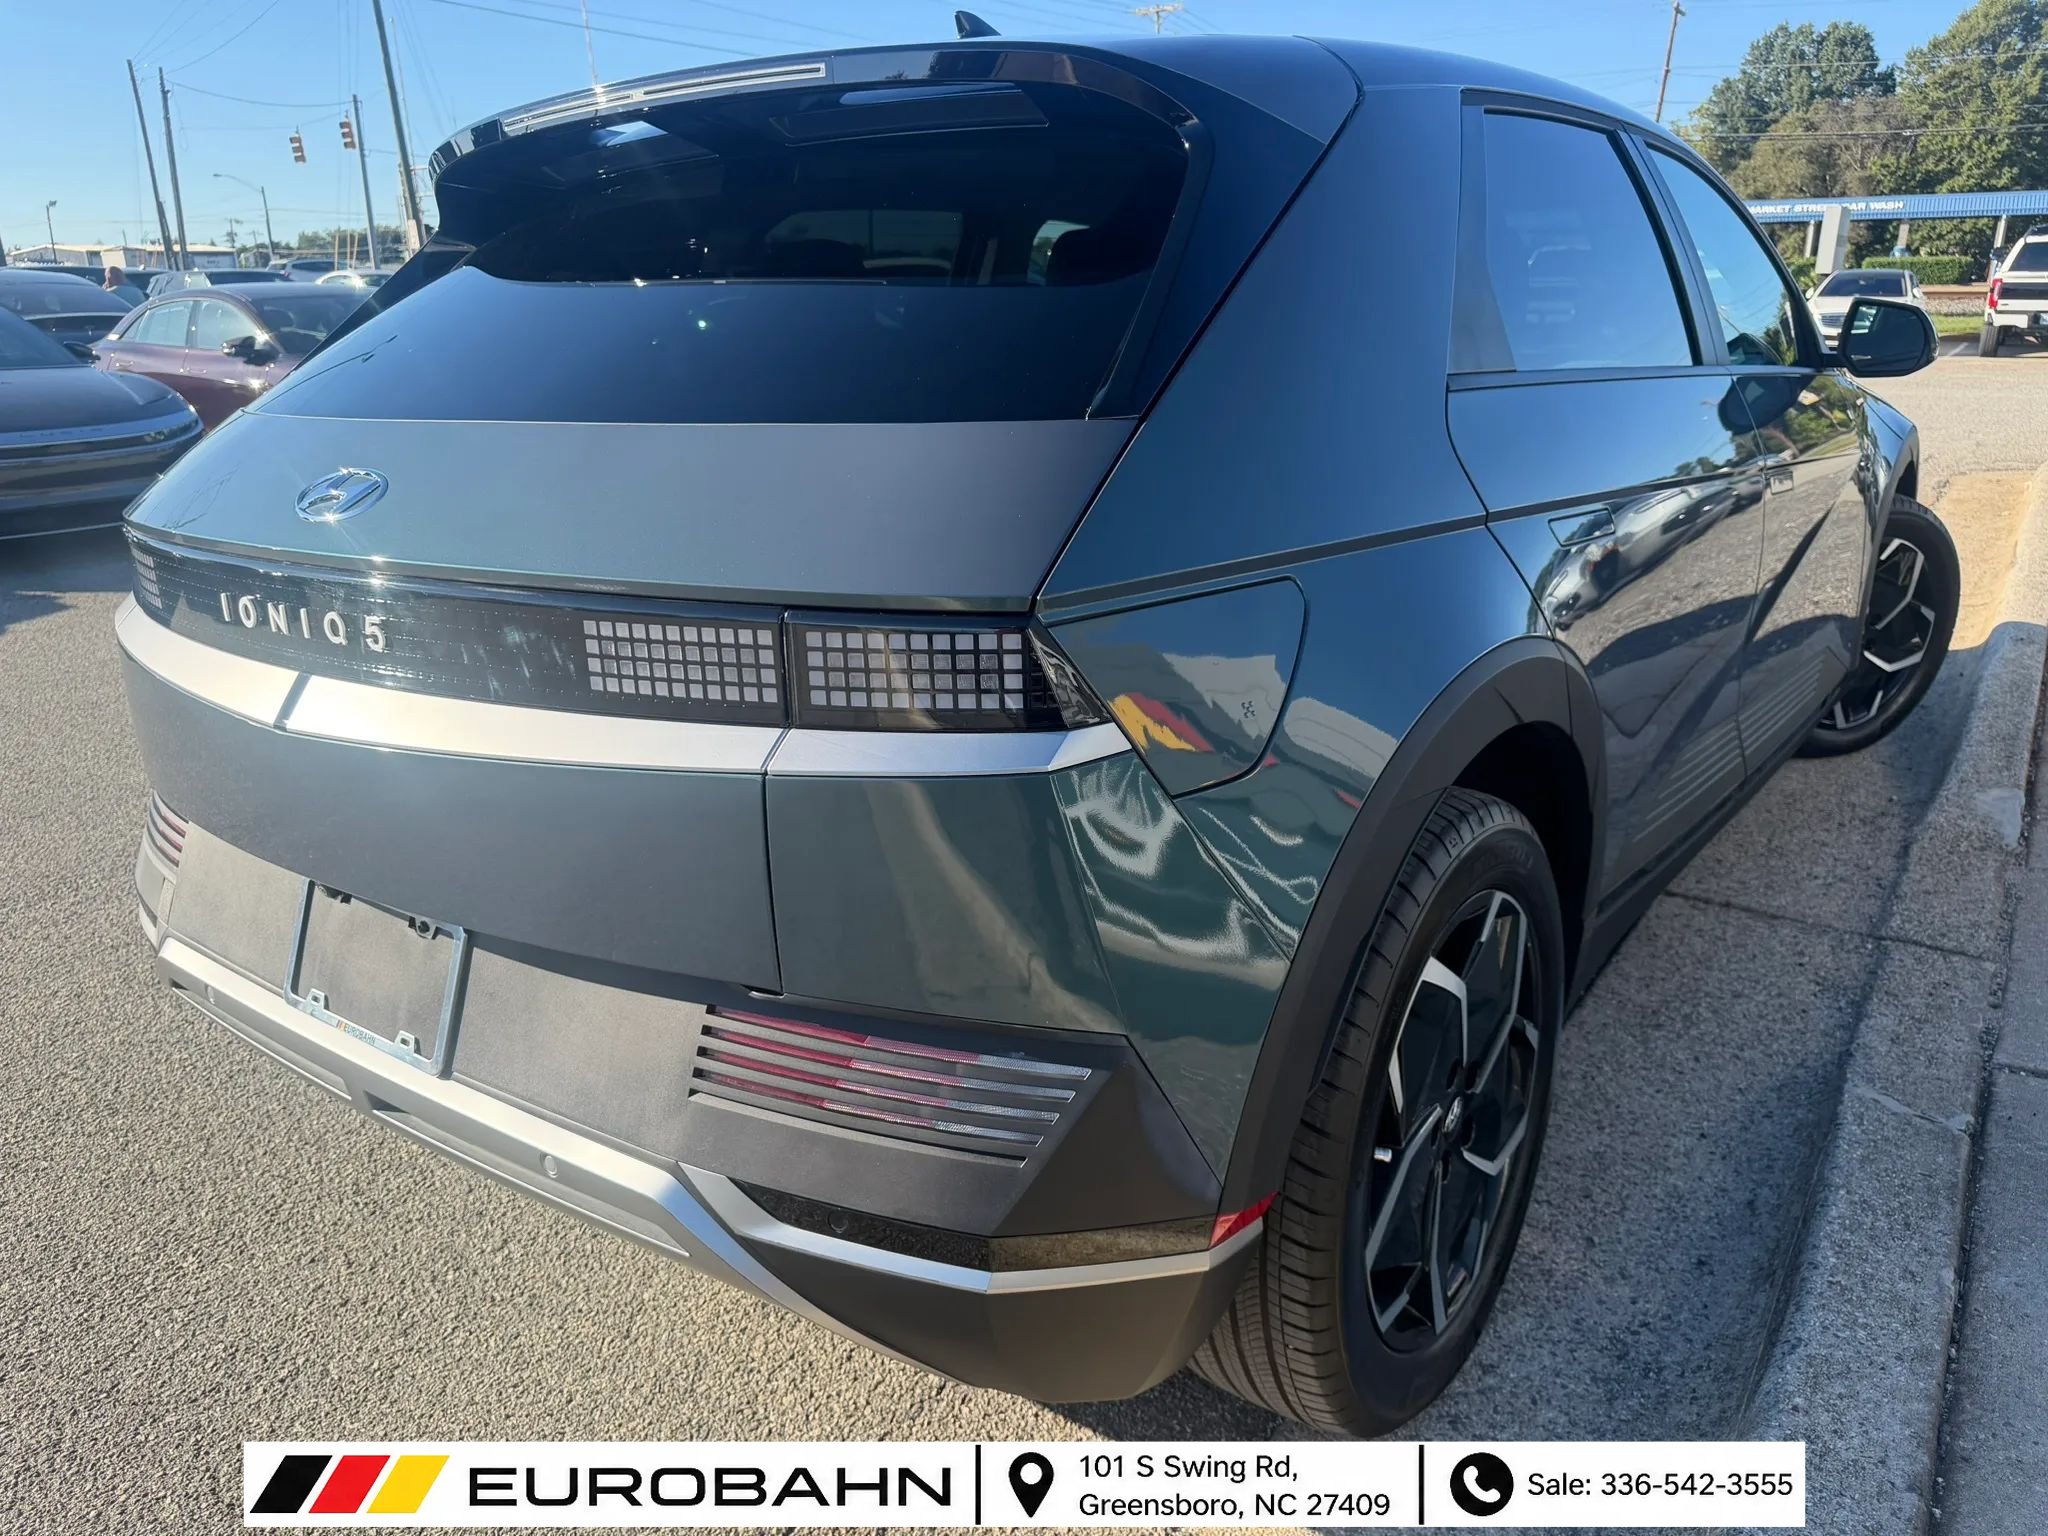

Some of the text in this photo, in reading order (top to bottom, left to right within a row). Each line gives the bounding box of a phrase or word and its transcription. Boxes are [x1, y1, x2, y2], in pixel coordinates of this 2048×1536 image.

[1793, 203, 1826, 213] STRE
[1869, 200, 1904, 210] WASH
[220, 592, 388, 653] IONIQ 5
